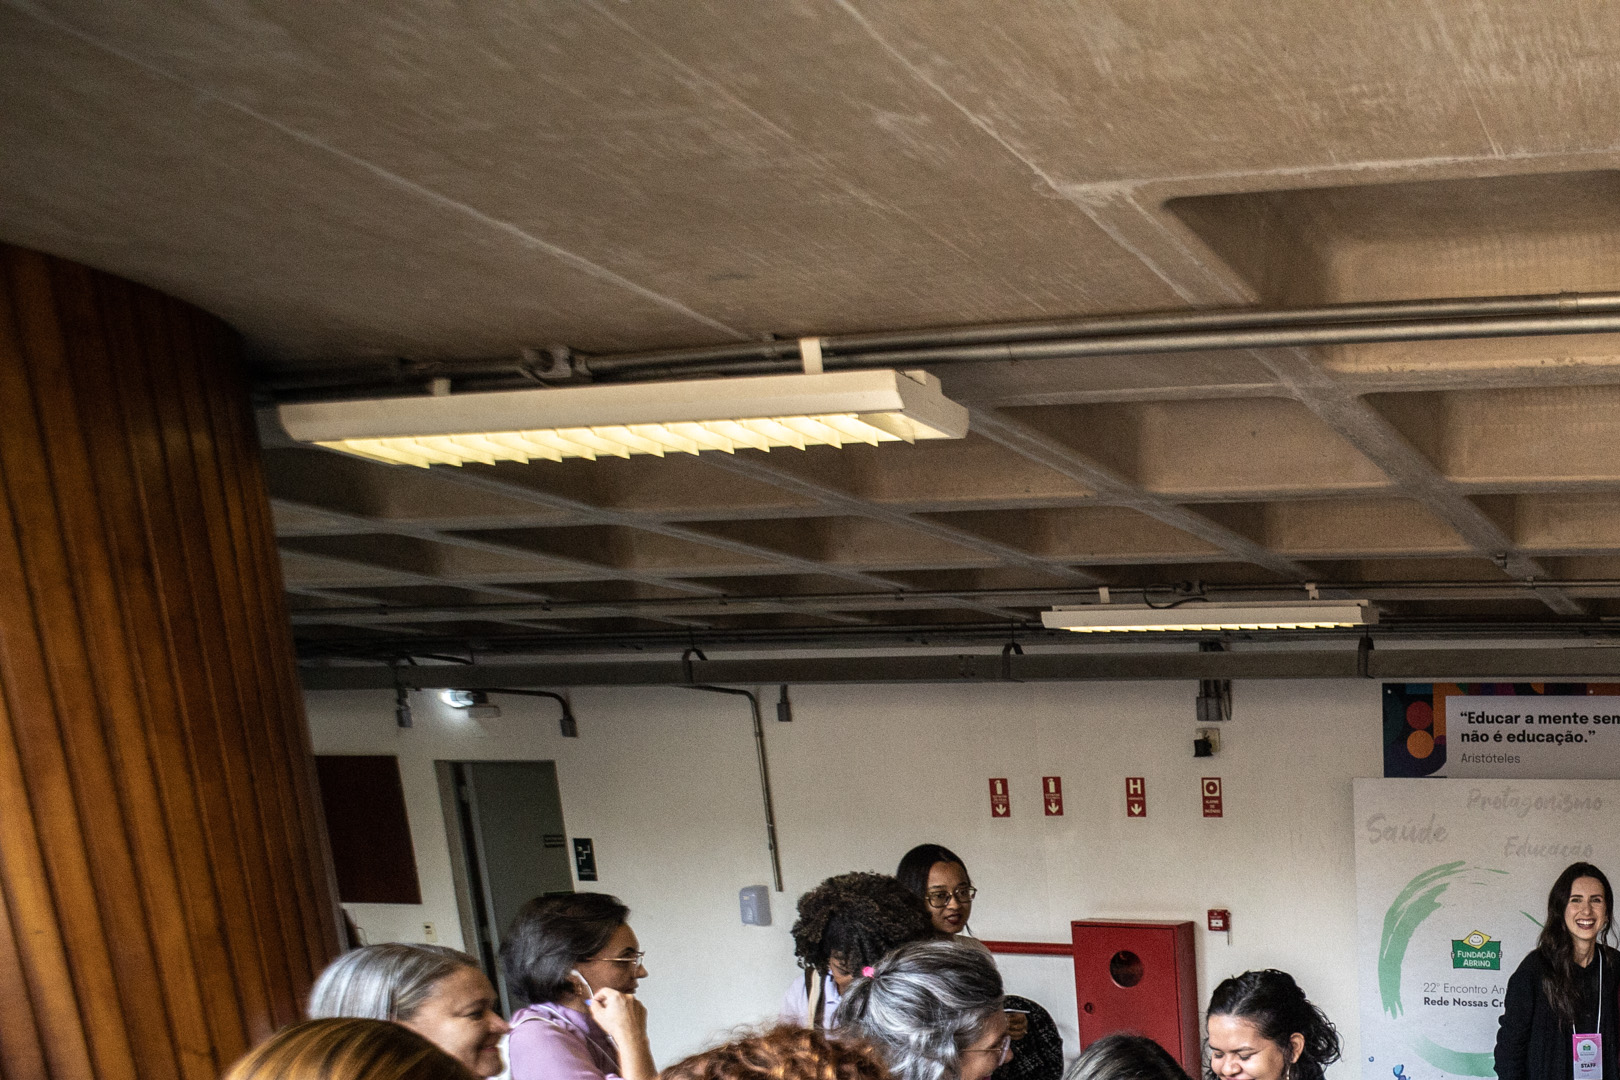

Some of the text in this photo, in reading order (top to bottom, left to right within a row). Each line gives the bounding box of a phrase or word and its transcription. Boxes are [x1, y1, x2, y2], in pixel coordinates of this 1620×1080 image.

[1460, 711, 1521, 726] “Educar
[1524, 714, 1534, 726] a
[1538, 713, 1589, 726] mente
[1460, 730, 1489, 744] não
[1493, 729, 1503, 744] é
[1460, 752, 1521, 765] Aristóteles
[1129, 779, 1141, 795] H
[1467, 787, 1603, 818] Protagonismo
[1366, 812, 1449, 845] Saúde
[1457, 950, 1497, 960] FUNDAÇÃO
[1462, 958, 1491, 968] ABRINQ
[1443, 983, 1488, 995] Encontro
[1423, 996, 1450, 1007] Rede
[1452, 997, 1488, 1008] Nossas
